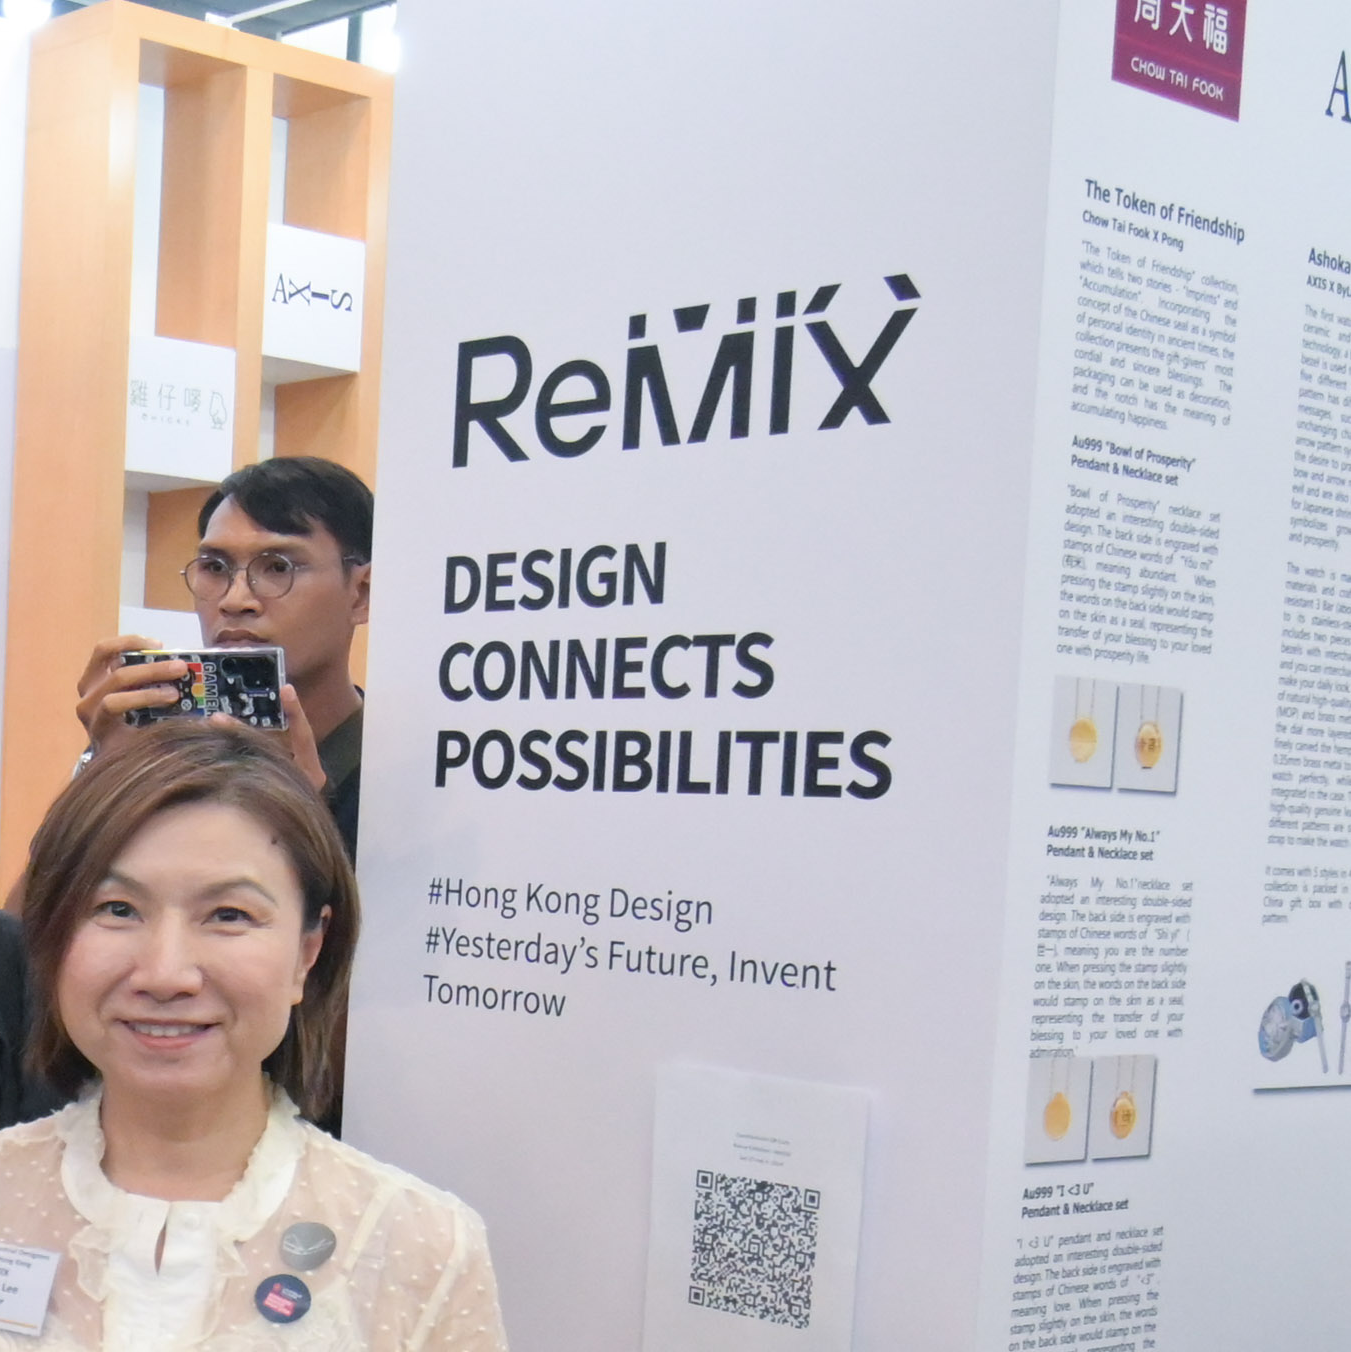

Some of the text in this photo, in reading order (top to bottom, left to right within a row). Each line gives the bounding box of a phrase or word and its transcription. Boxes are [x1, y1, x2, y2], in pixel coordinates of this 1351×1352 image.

[1134, 0, 1229, 55] 周大福
[1131, 57, 1224, 101] CHOW TAI FOOK
[1082, 210, 1184, 252] Chow Tai Fook X Pong
[1085, 179, 1245, 245] The Token of Friendship
[1308, 247, 1351, 275] Ashoka
[1307, 275, 1327, 291] AXIS
[1329, 279, 1335, 293] X
[1071, 454, 1179, 486] Pendant & Necklace set
[1072, 435, 1196, 472] Au999 "Bowl of Prosperity"
[443, 541, 668, 615] DESIGN
[437, 631, 776, 703] CONNECTS
[204, 662, 220, 717] GAME
[433, 728, 894, 801] POSSIBILITIES
[1047, 844, 1153, 862] Pendant & Necklace set
[1048, 825, 1160, 844] Au999 "Always My No.1"
[427, 877, 715, 929] #Hong Kong Design
[424, 926, 838, 993] #Yesterday’s Future, Invent
[422, 974, 568, 1018] Tomorrow
[1022, 1199, 1129, 1219] Pendant & Necklace set
